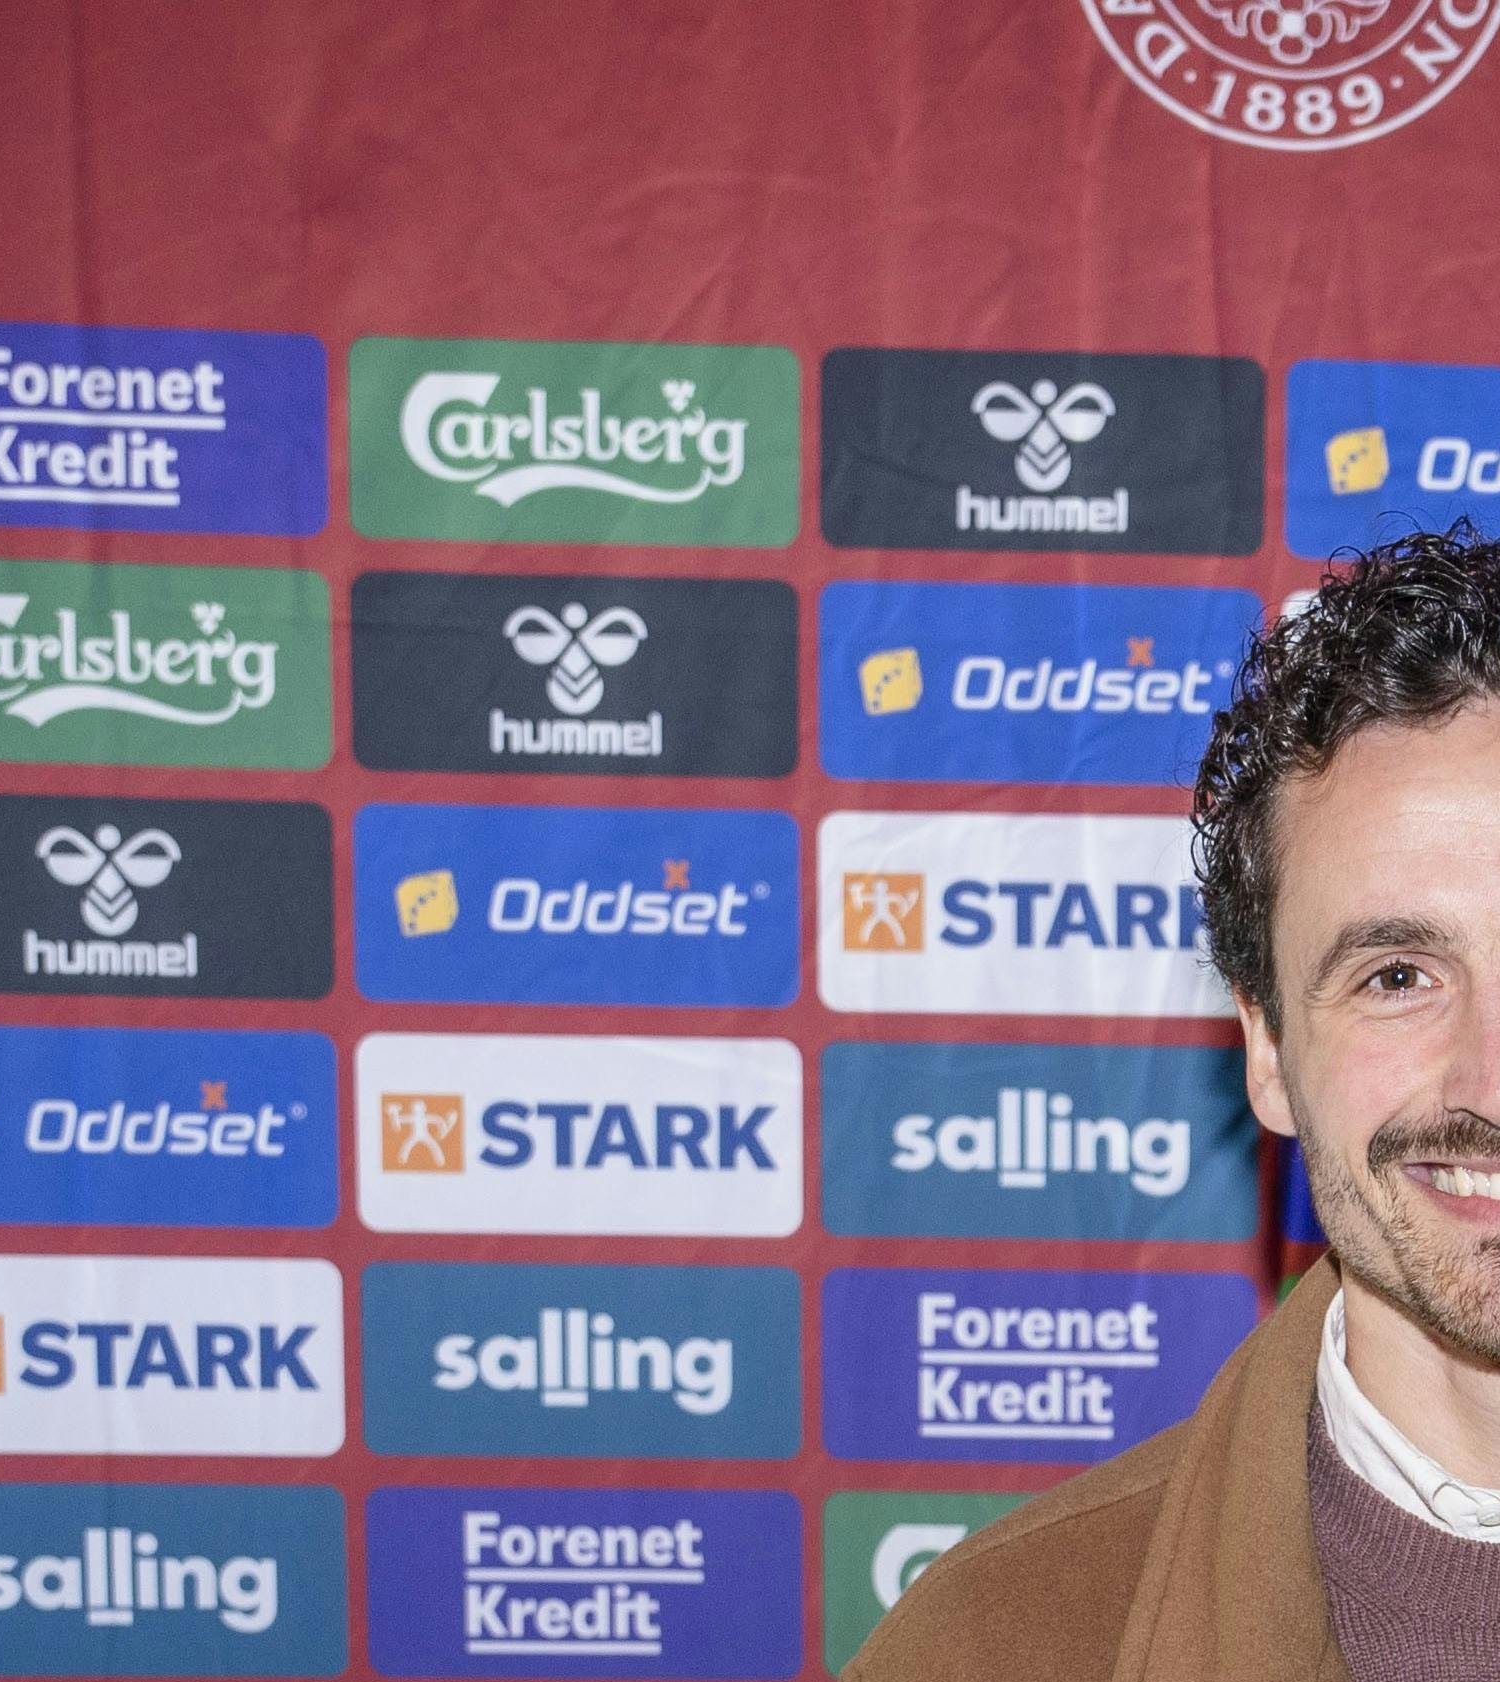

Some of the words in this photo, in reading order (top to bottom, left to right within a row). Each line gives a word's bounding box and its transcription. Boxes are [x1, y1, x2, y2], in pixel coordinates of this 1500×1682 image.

[1203, 70, 1384, 135] 1889
[400, 371, 747, 507] Carlsberg
[956, 486, 1129, 534] hummel
[490, 709, 663, 756] hummel
[23, 930, 198, 978] hummel
[478, 1100, 776, 1171] STARK
[892, 1088, 1191, 1197] salling
[919, 1294, 1158, 1351] Forenet
[18, 1320, 318, 1391] STARK
[434, 1308, 733, 1415] salling
[919, 1367, 1114, 1424] Kredit
[464, 1512, 704, 1567] Forenet
[466, 1584, 661, 1639] Kredit
